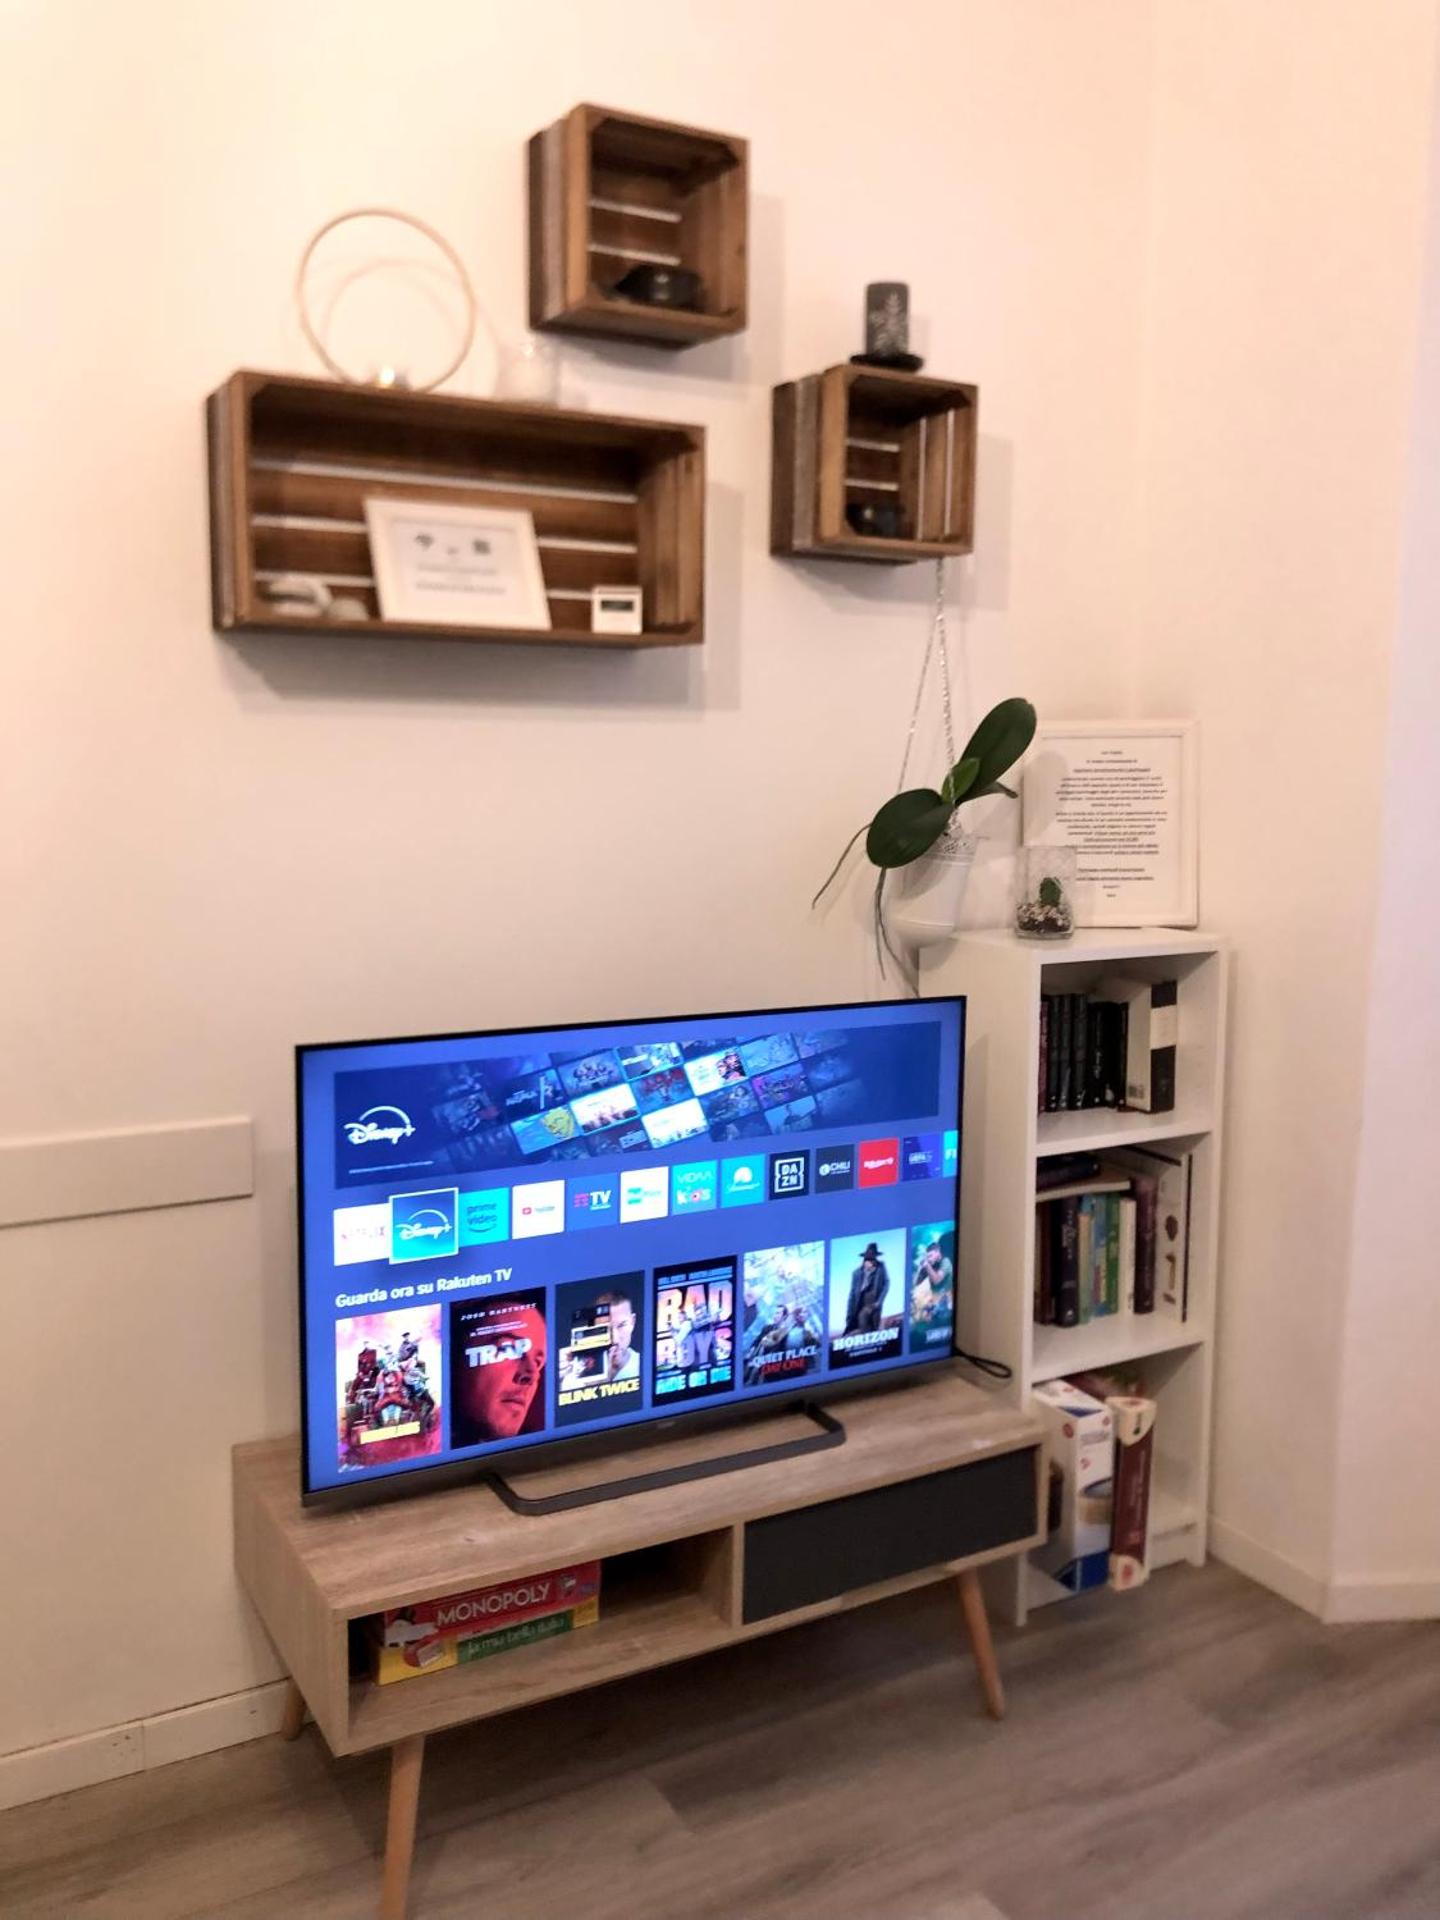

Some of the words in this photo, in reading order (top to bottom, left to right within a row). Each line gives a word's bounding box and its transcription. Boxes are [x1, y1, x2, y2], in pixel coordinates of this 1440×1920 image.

[335, 1289, 387, 1307] Guarda
[390, 1285, 414, 1299] ora
[416, 1282, 434, 1295] su
[437, 1272, 492, 1291] Rakuten
[494, 1267, 513, 1281] TV
[657, 1279, 733, 1334] BAD
[465, 1338, 532, 1368] TRAP
[832, 1327, 900, 1351] HORIZON
[558, 1386, 599, 1406] BLINK
[600, 1379, 641, 1398] TWICE
[437, 1582, 550, 1626] MONOPOLY
